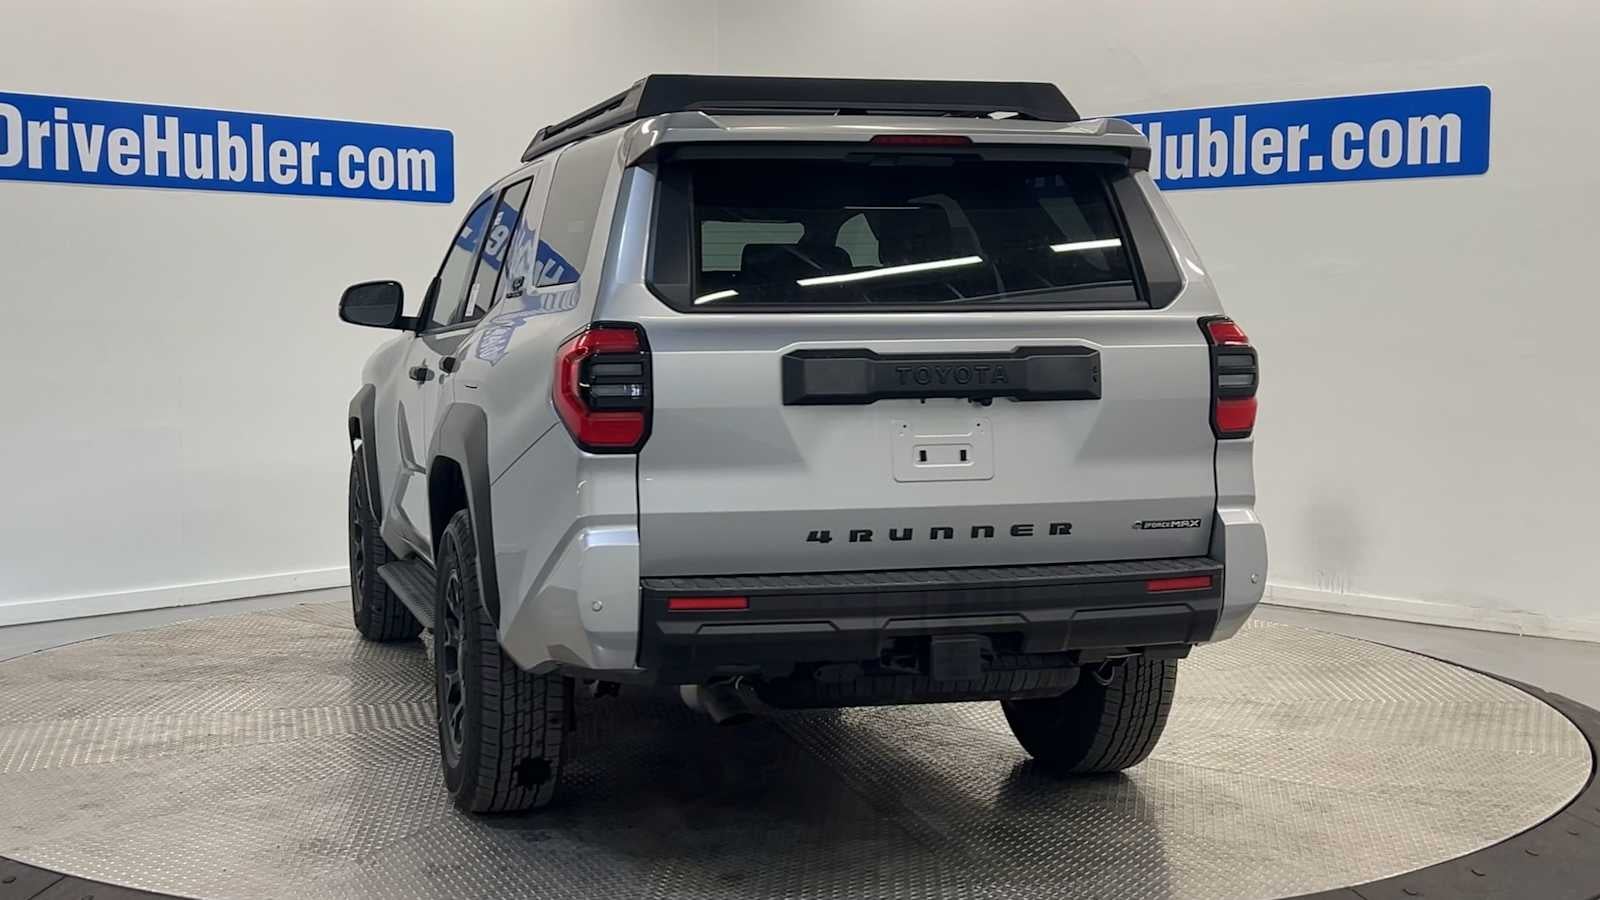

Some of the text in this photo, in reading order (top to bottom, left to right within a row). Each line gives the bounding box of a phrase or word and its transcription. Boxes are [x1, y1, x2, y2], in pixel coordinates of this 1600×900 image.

[0, 103, 436, 192] DriveHubler.com
[896, 366, 1009, 386] TOYOTA
[806, 522, 1073, 544] 4RUNNER
